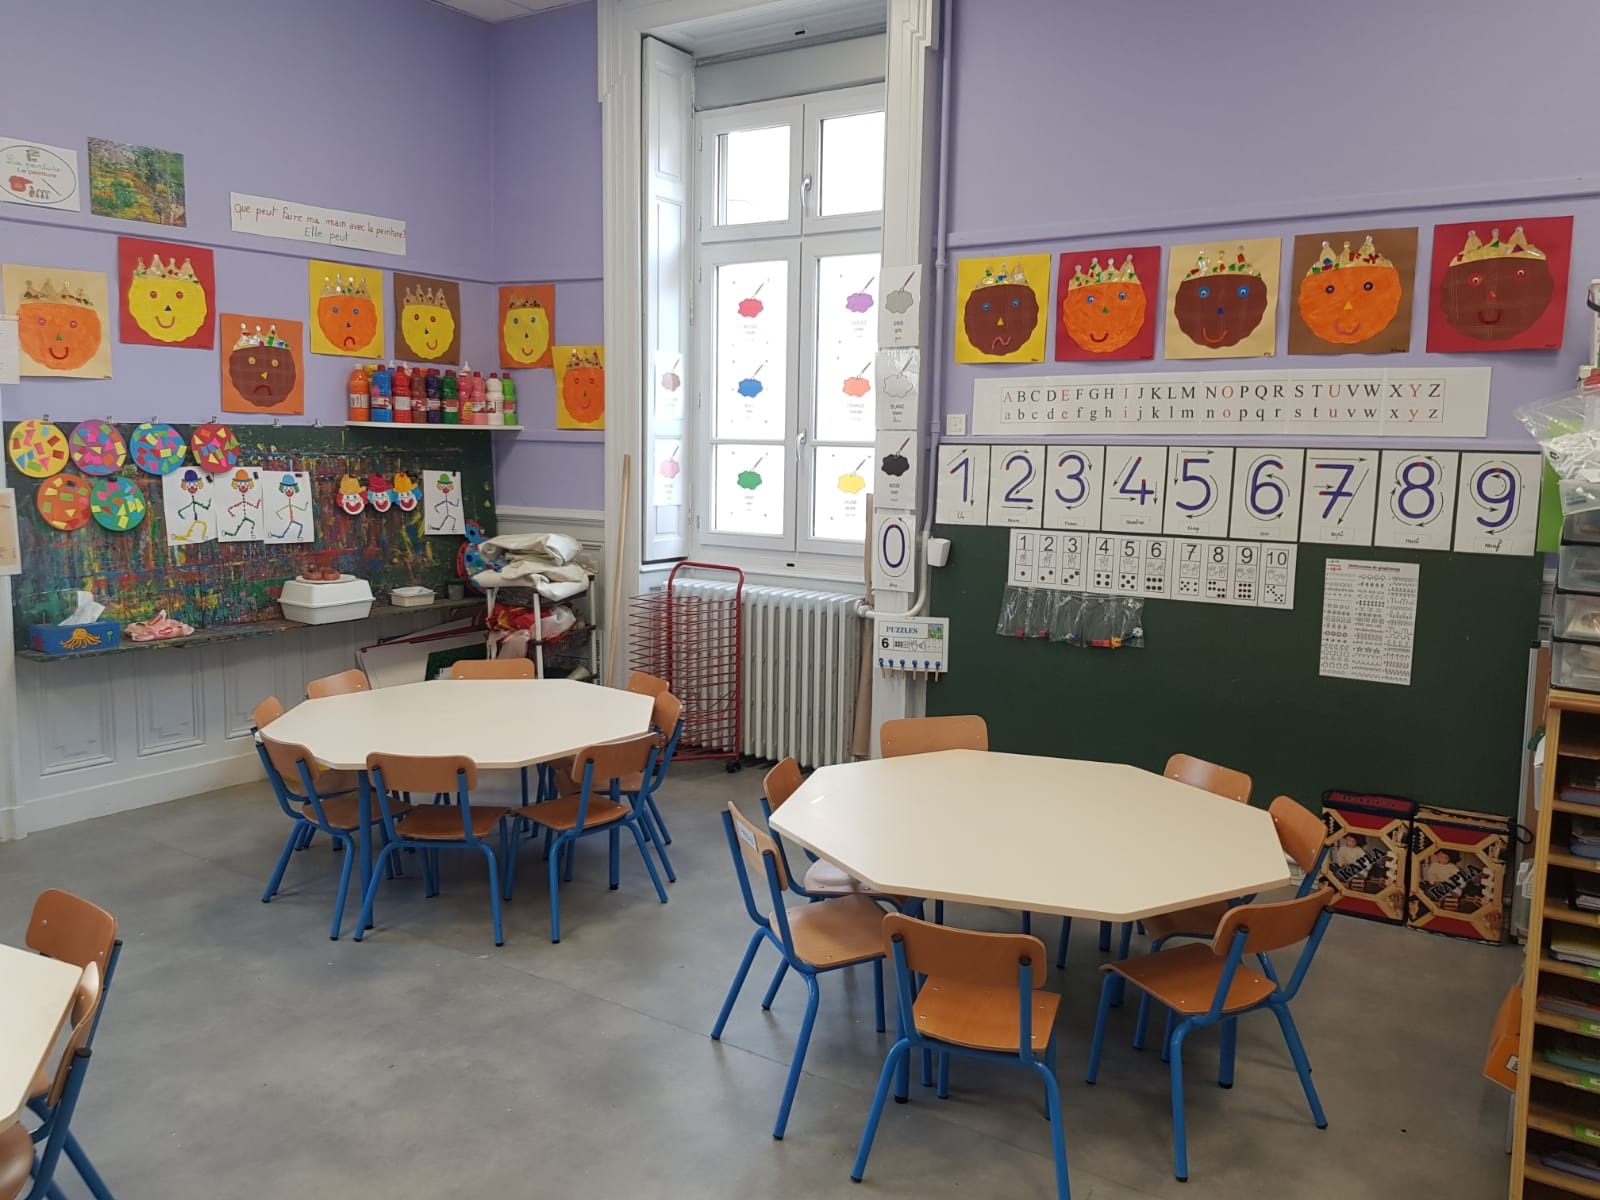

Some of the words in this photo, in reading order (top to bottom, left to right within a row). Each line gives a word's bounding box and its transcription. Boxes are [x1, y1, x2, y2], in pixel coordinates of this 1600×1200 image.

[234, 203, 252, 221] Que
[256, 205, 279, 222] peut
[282, 206, 303, 222] faire
[306, 216, 321, 225] ma
[325, 219, 347, 228] main
[349, 223, 366, 232] avec
[367, 221, 374, 233] la
[304, 225, 324, 238] Elle
[1003, 391, 1013, 403] A
[1017, 390, 1027, 402] B
[1030, 389, 1041, 402] C
[1046, 389, 1057, 401] D
[1060, 389, 1070, 401] E
[1076, 388, 1084, 400] F
[1088, 387, 1100, 400] G
[1103, 387, 1114, 399] H
[1124, 387, 1128, 399] I
[1137, 386, 1145, 399] J
[1151, 386, 1163, 399] K
[1167, 386, 1178, 399] L
[1181, 385, 1196, 399] M
[1205, 385, 1217, 399] N
[1221, 385, 1234, 398] O
[1239, 385, 1250, 398] P
[1254, 384, 1268, 400] Q
[1272, 384, 1285, 398] R
[1294, 384, 1305, 397] S
[1311, 384, 1324, 397] T
[1328, 384, 1342, 397] U
[1346, 383, 1361, 397] V
[1362, 383, 1382, 397] W
[1388, 383, 1403, 397] X
[1408, 383, 1423, 397] Y
[1427, 383, 1441, 397] Z
[949, 457, 969, 503] 1
[1004, 455, 1034, 503] 2
[1055, 454, 1086, 503] 3
[1119, 456, 1155, 506] 4
[1176, 458, 1211, 511] 5
[1250, 459, 1284, 515] 6
[1315, 463, 1355, 519] 7
[1398, 461, 1435, 519] 8
[1476, 467, 1516, 528] 9
[883, 524, 906, 569] 0
[1020, 535, 1026, 550] 1
[1044, 536, 1054, 552] 2
[1068, 537, 1078, 553] 3
[1099, 540, 1110, 554] 4
[1125, 541, 1135, 557] 5
[1151, 542, 1162, 558] 6
[1186, 544, 1197, 560] 7
[1213, 546, 1224, 562] 8
[1241, 547, 1253, 563] 9
[1267, 551, 1287, 566] 10
[881, 637, 890, 649] 6
[886, 625, 918, 634] PUZZLES
[1339, 847, 1387, 881] KAPLA
[1430, 864, 1483, 899] KAPLA
